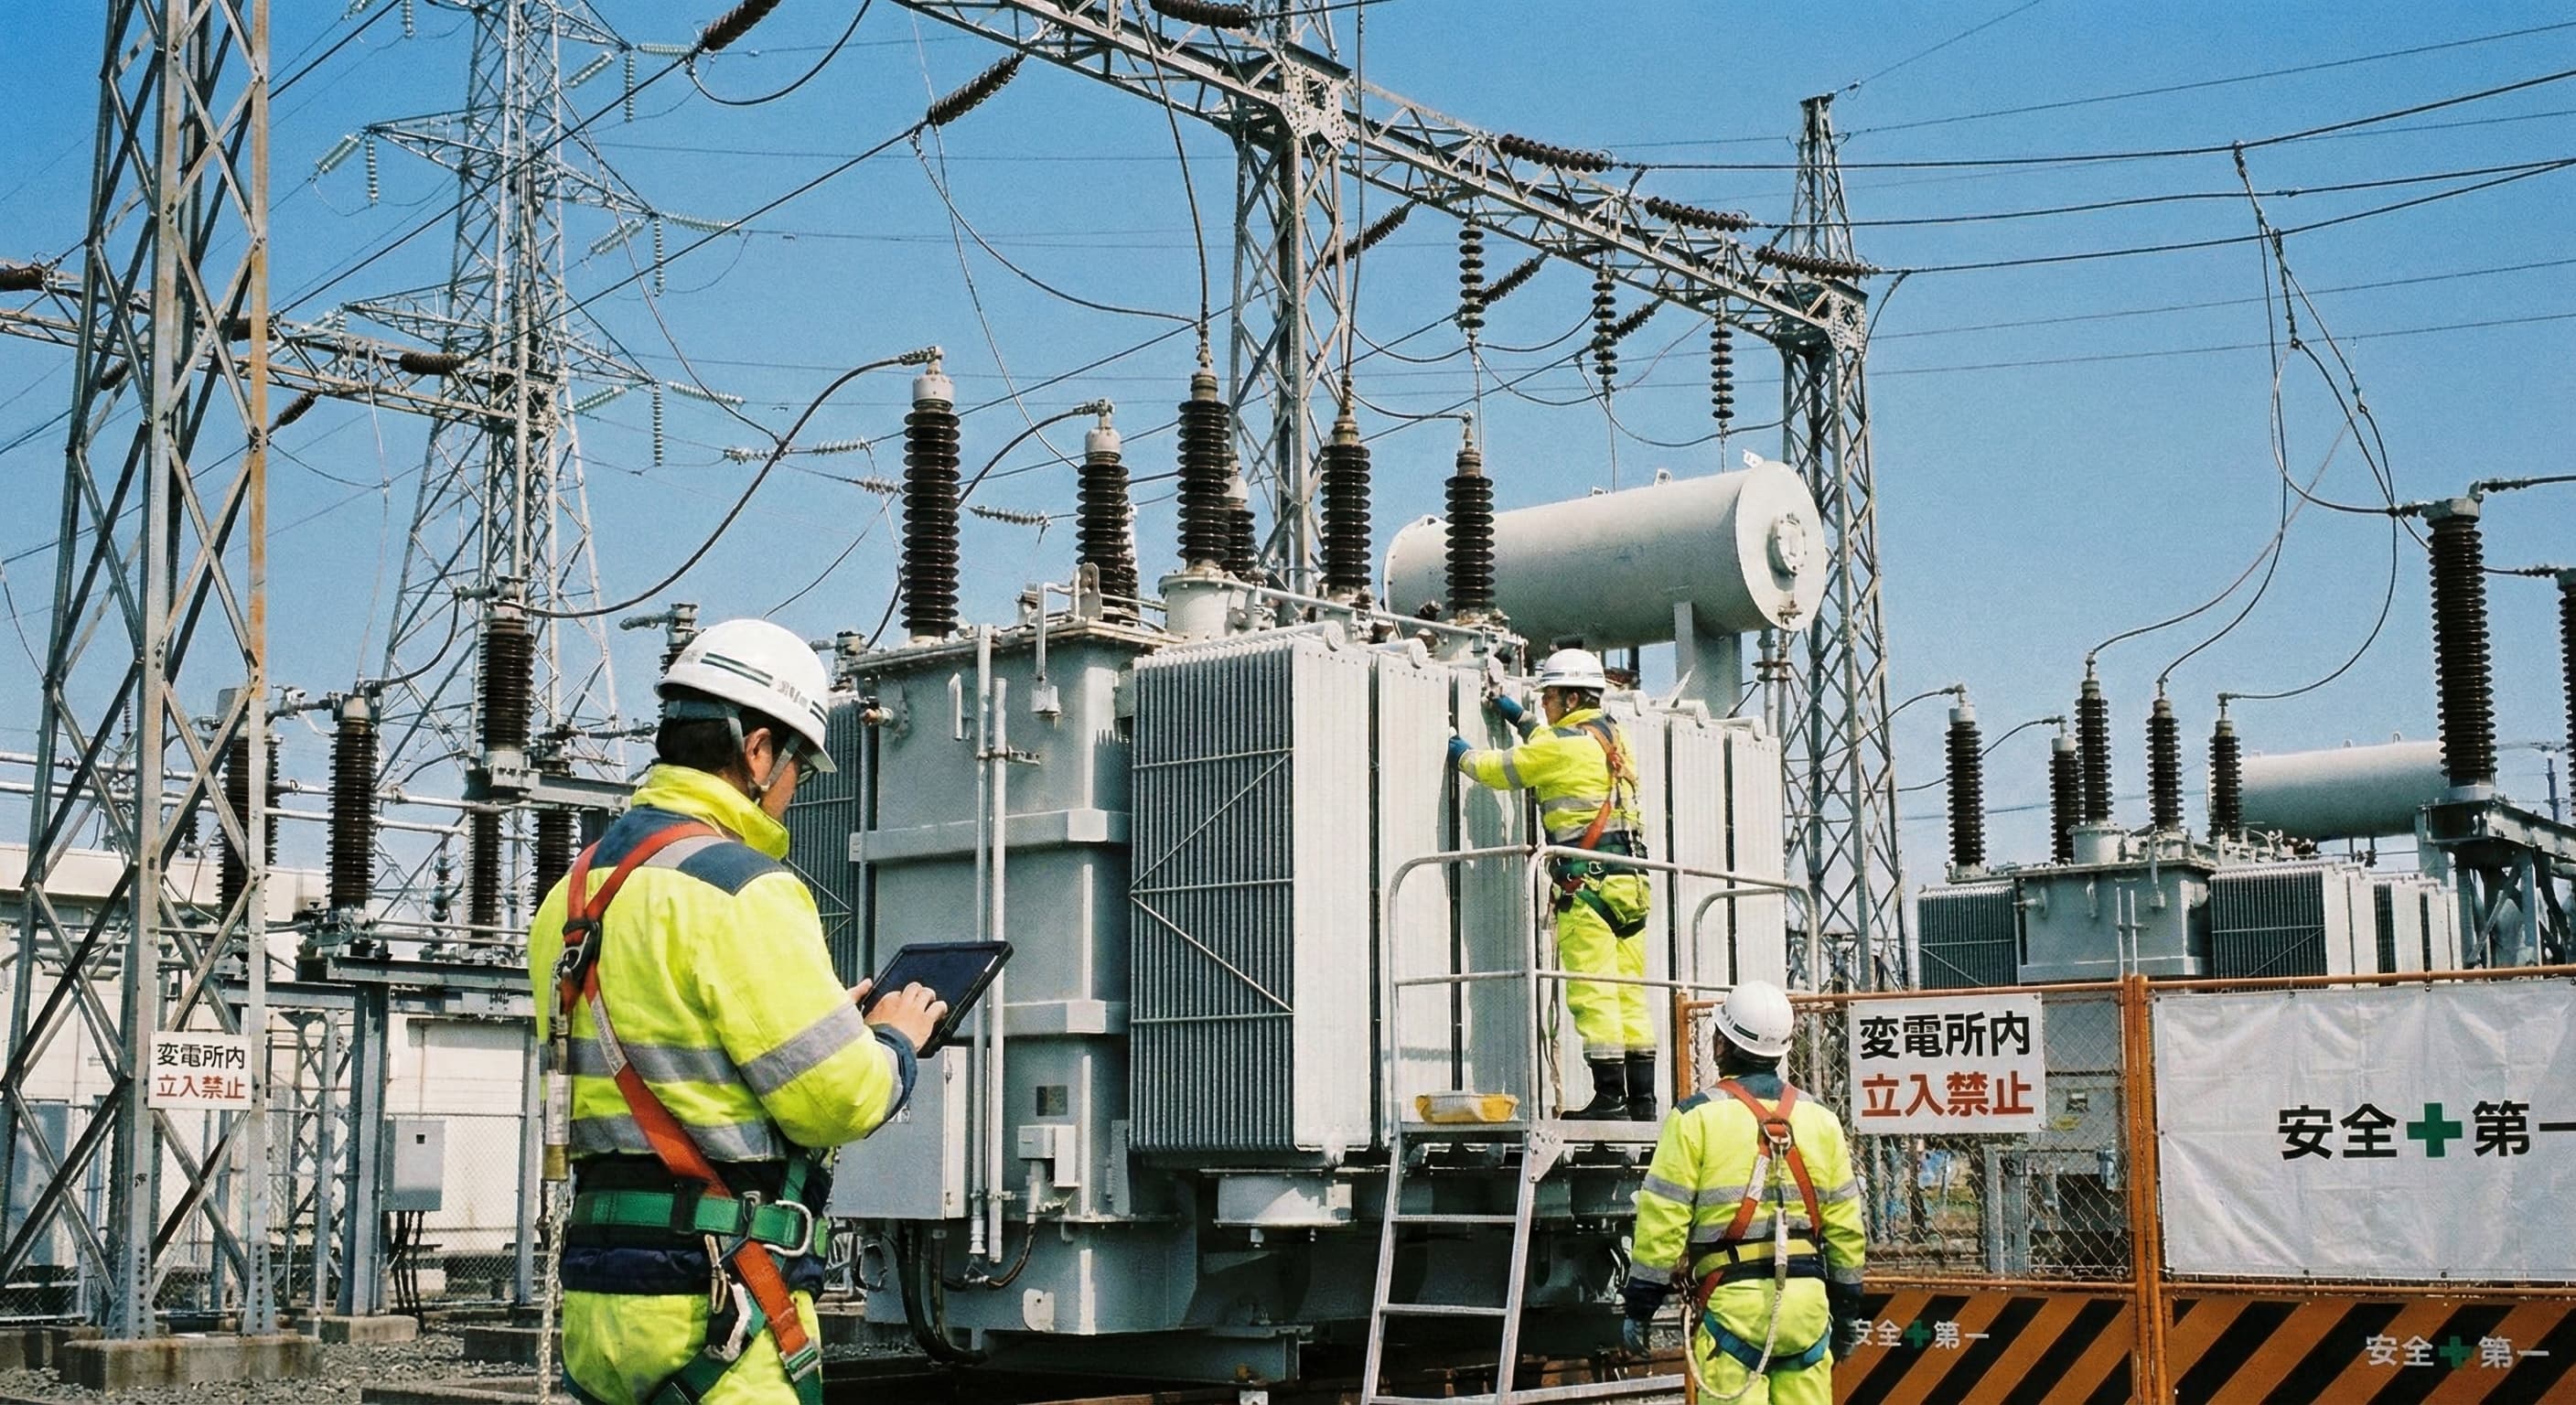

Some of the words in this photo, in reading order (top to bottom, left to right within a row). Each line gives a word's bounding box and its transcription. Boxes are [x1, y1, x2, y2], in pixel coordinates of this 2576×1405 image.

[156, 1042, 245, 1070] 変電所内
[1859, 1010, 2030, 1060] 変電所内
[156, 1074, 246, 1099] 立入禁止
[1861, 1069, 2034, 1118] 立入禁止
[2278, 1102, 2398, 1161] 安全
